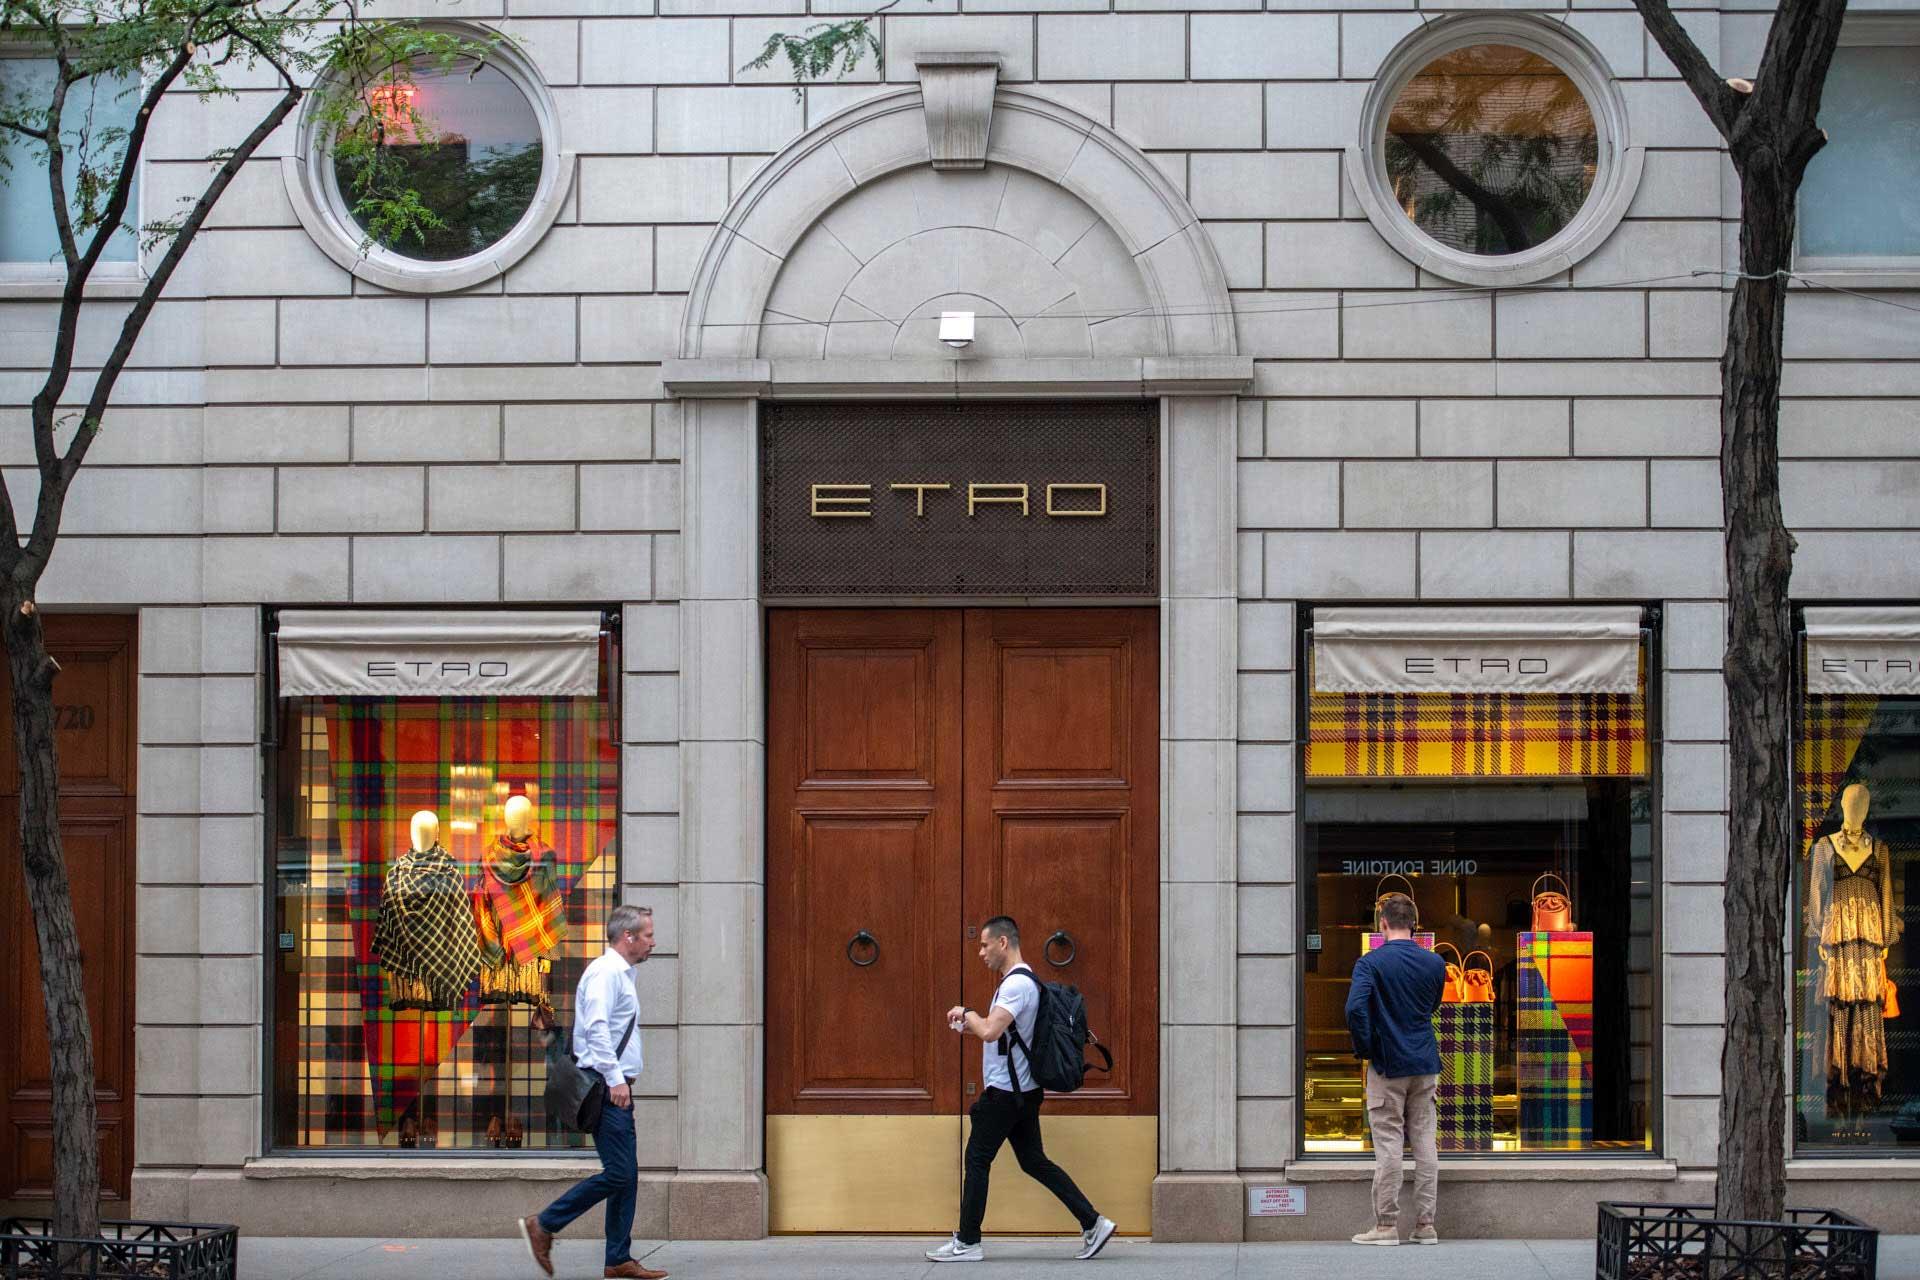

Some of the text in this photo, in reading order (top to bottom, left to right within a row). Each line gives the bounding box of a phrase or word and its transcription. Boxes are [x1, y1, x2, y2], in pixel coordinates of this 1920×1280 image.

[811, 482, 1107, 518] ETRO
[367, 661, 508, 677] ETRO
[1405, 658, 1548, 674] ETRO
[1822, 658, 1920, 673] ETR
